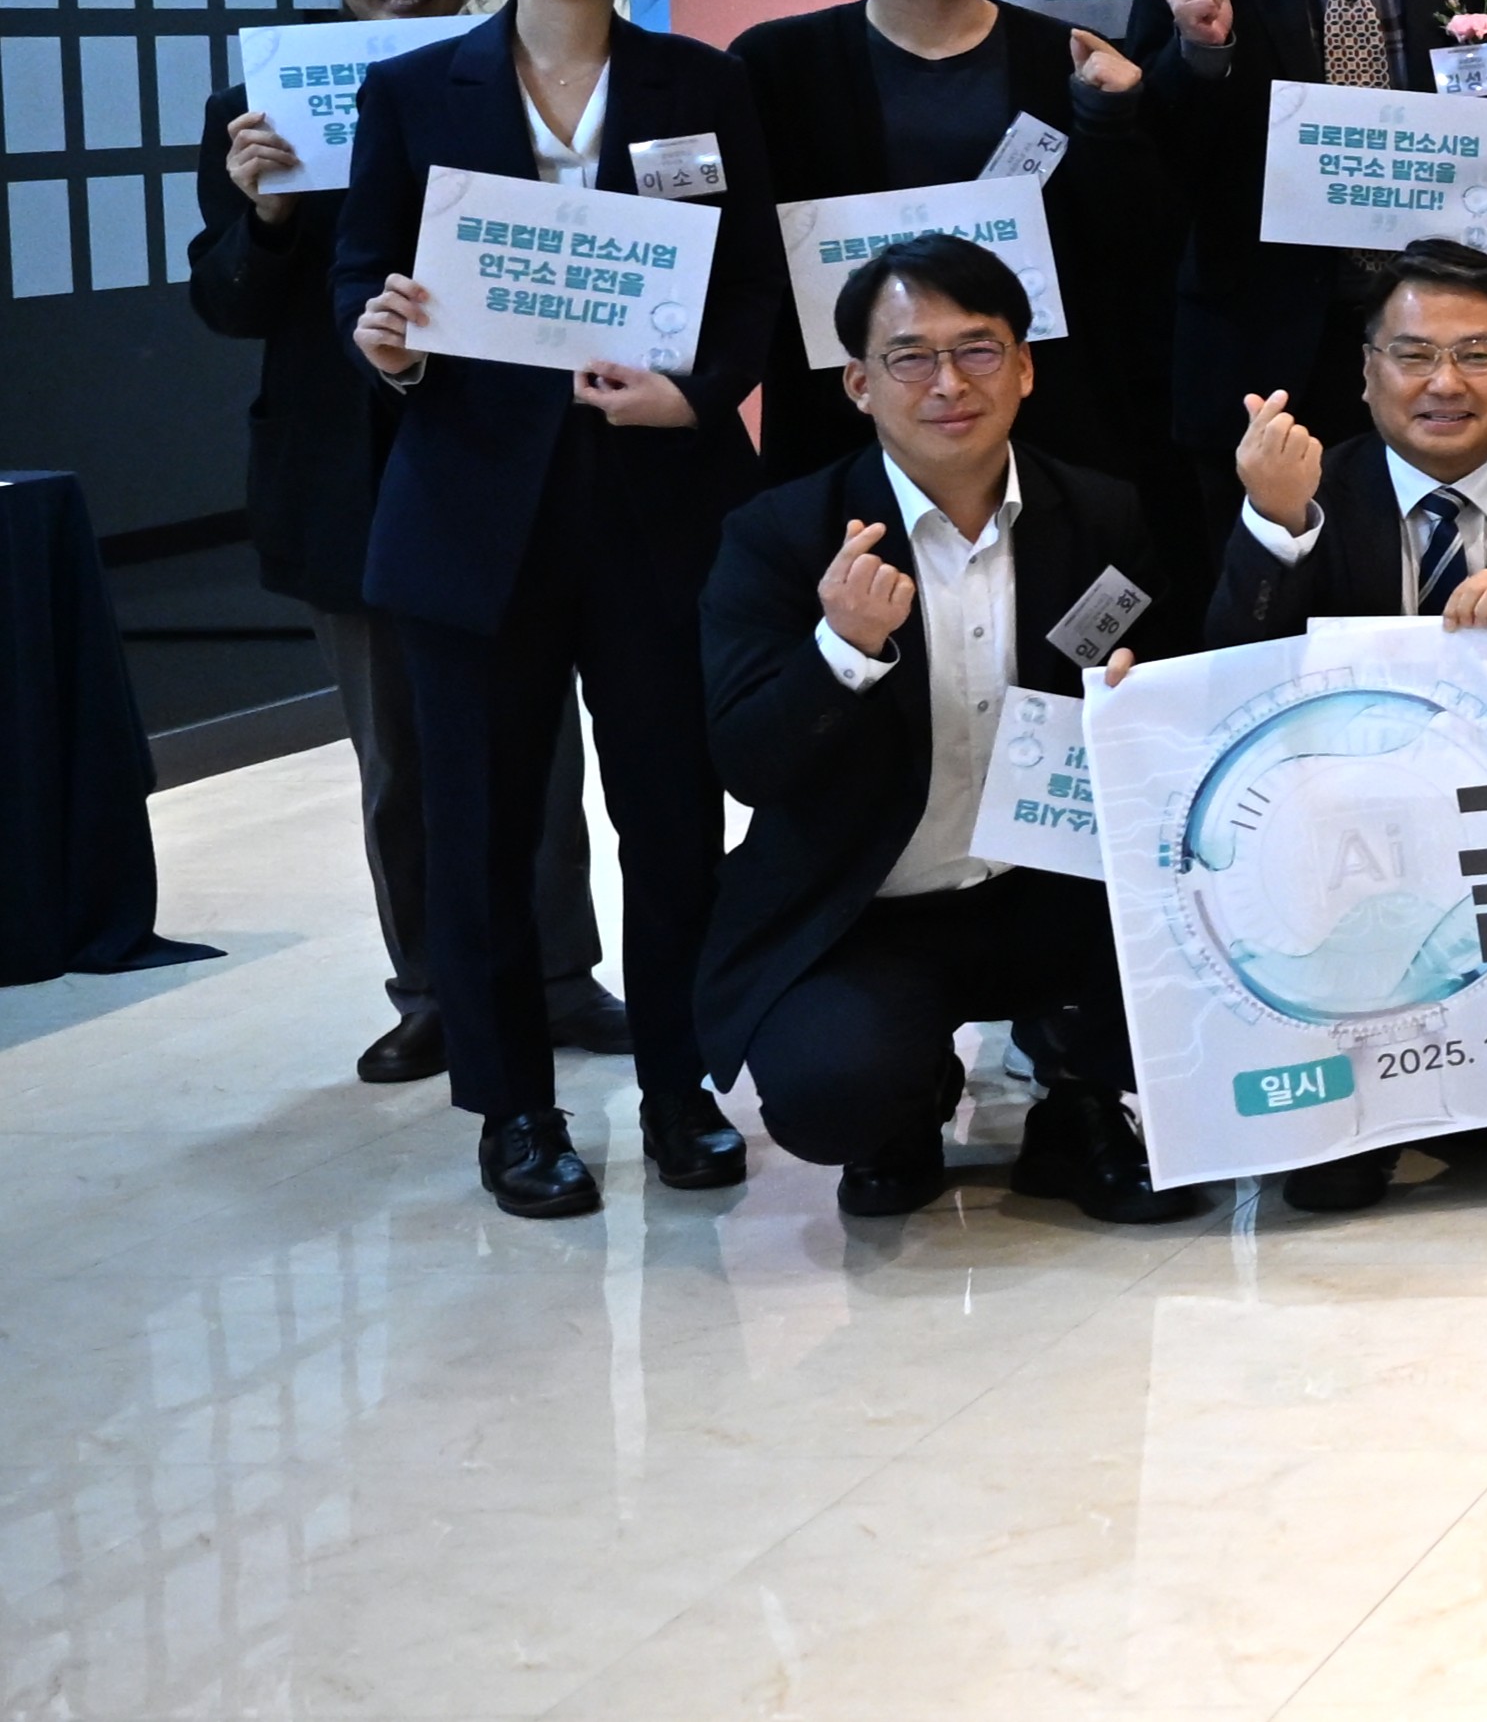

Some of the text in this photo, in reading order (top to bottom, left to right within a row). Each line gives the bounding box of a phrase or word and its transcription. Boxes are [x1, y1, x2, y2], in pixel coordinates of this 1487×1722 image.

[1298, 123, 1480, 158] 글로컬랩 컨소시엄
[643, 162, 720, 192] 이소영
[1318, 153, 1457, 184] 연구소 발전을
[1326, 182, 1445, 211] 응원합니다!
[456, 217, 678, 270] 글로컬랩 컨소시엄
[479, 253, 646, 299] 연구소 발전을
[487, 286, 629, 328] 응원합니다!
[1258, 1068, 1328, 1110] 일시
[1375, 1038, 1477, 1081] 2025.
